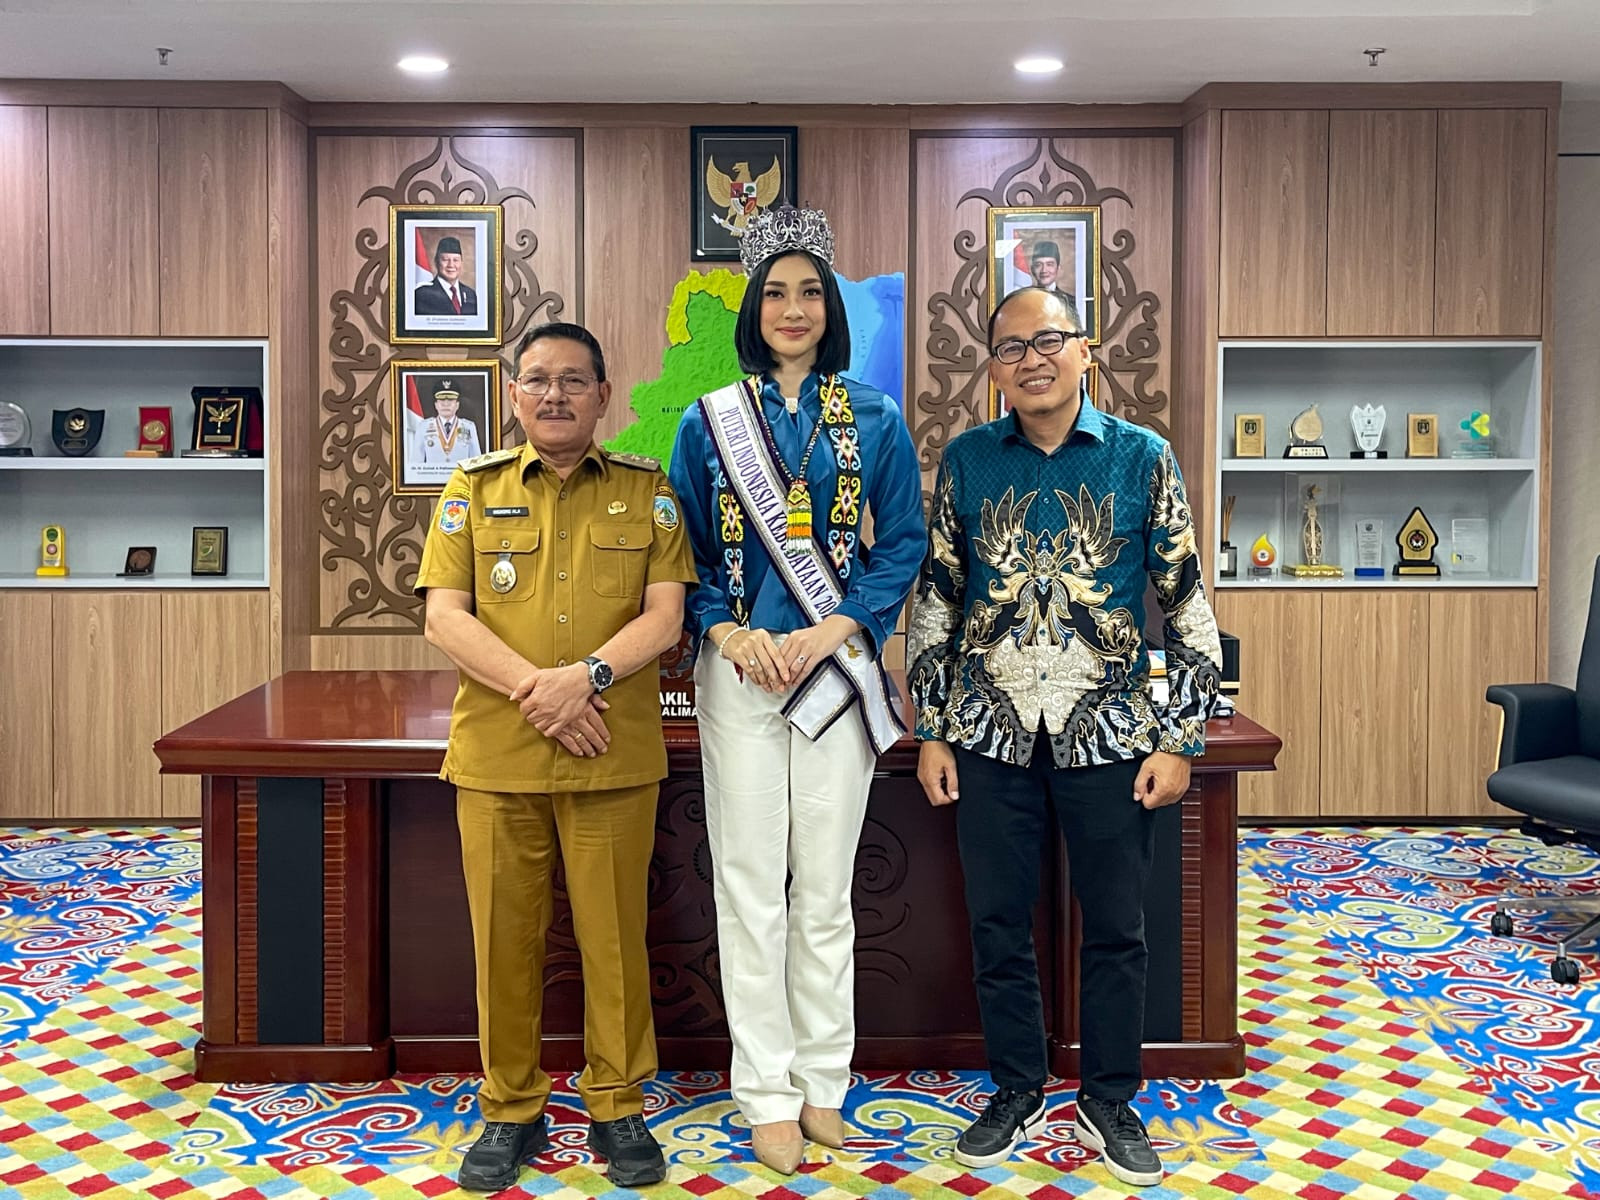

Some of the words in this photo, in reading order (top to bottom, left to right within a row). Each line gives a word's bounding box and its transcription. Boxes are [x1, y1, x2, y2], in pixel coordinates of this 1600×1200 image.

[718, 406, 750, 447] PUTERI
[732, 443, 779, 516] INDONESIA
[814, 595, 837, 619] 20
